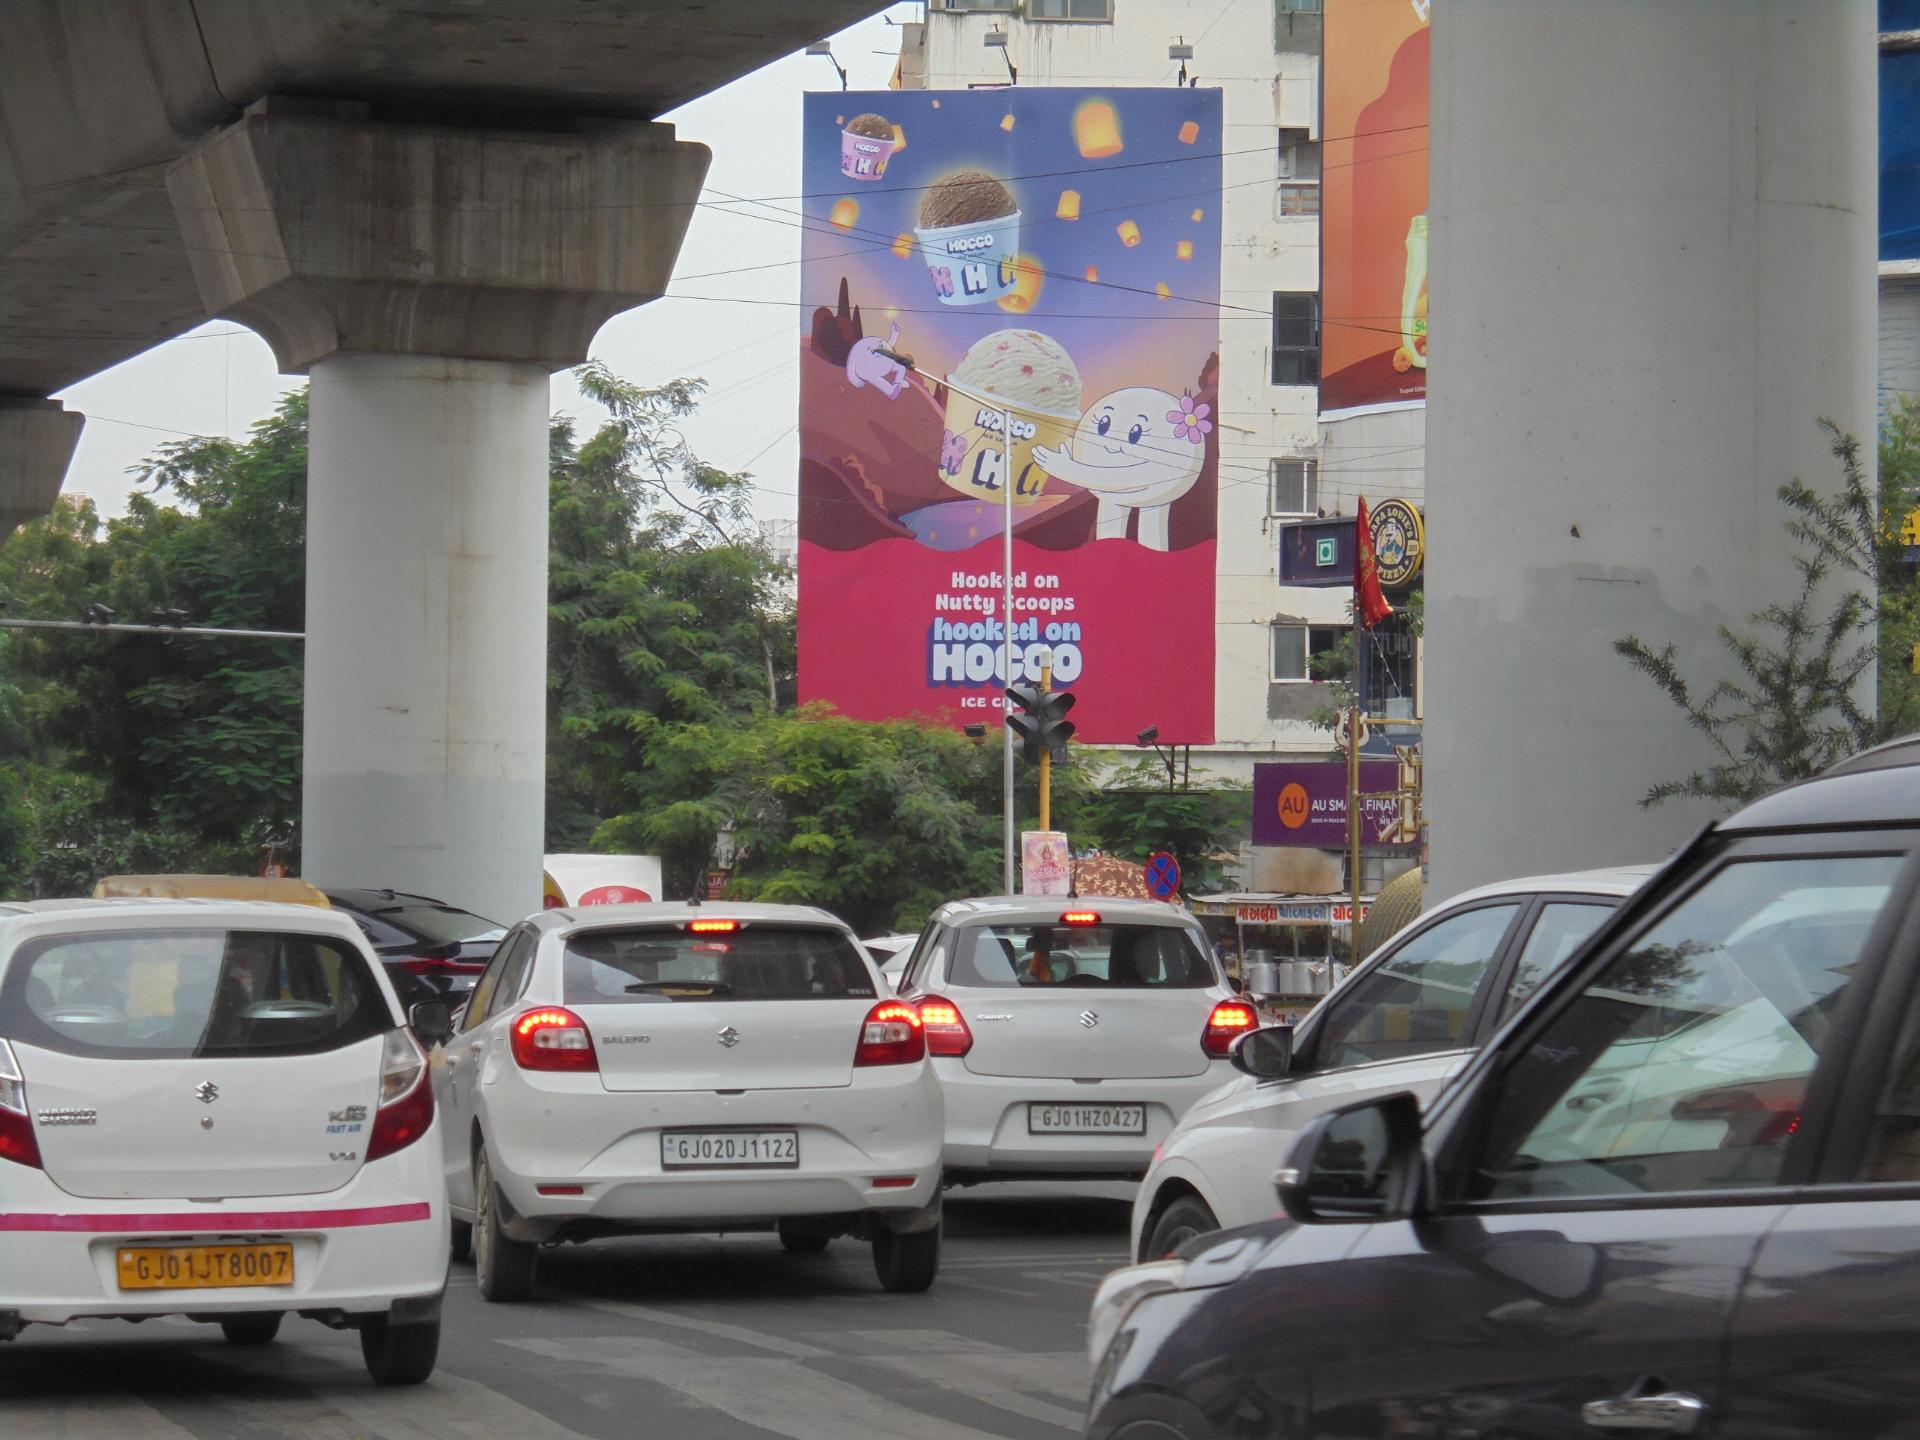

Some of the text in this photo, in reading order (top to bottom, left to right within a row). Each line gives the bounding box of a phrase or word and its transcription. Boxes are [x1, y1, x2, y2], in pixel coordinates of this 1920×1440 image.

[947, 233, 994, 254] HOCCO
[1387, 508, 1414, 538] LOUIE'S
[1377, 565, 1405, 580] PIZZA
[1034, 575, 1059, 588] on
[936, 594, 995, 615] Nutty
[934, 617, 1081, 641] hooked on
[932, 642, 1082, 683] HOCCO
[961, 697, 986, 708] ICE
[1282, 796, 1304, 814] AU
[1311, 799, 1398, 811] AU SML FINAN
[976, 1014, 1014, 1022] SWIFT
[602, 1036, 649, 1045] BALENO
[39, 1115, 96, 1126] SUZUKI
[1043, 1110, 1141, 1127] GJ01HZ0427
[679, 1139, 795, 1159] GJ02DJ1122
[136, 1251, 288, 1280] GJ01JT8007
